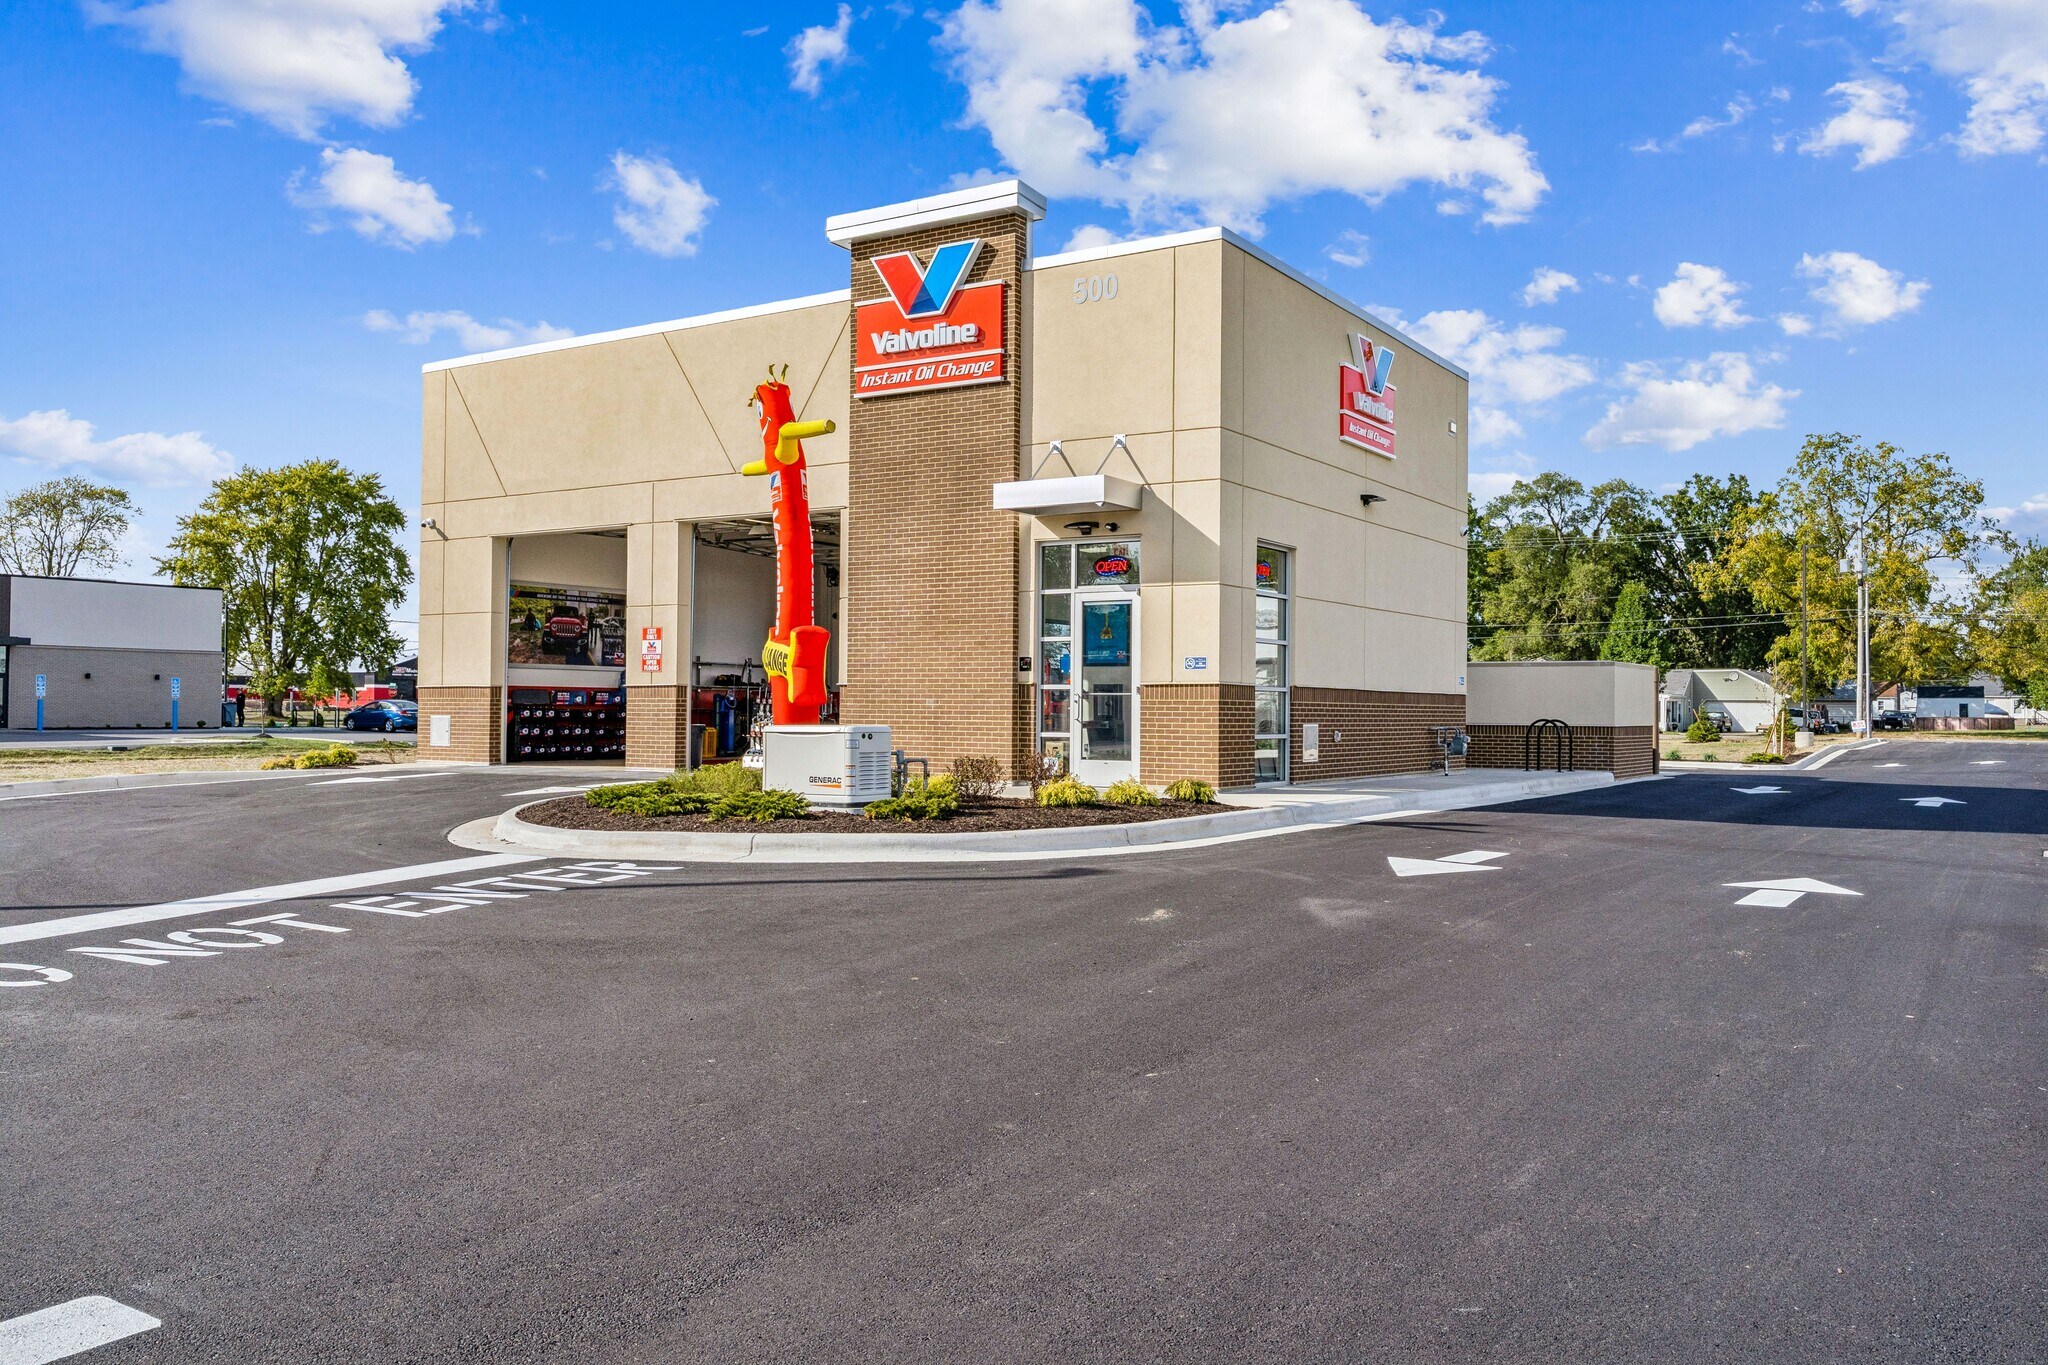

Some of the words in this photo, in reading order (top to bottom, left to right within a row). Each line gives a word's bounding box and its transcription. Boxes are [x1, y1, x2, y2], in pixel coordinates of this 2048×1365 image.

[1072, 272, 1119, 304] 500
[870, 322, 978, 355] Valvoline
[860, 368, 913, 388] Instant
[915, 365, 935, 380] Oil
[936, 360, 995, 378] Change
[1353, 391, 1394, 424] Valvoline
[1096, 560, 1128, 572] OPEN
[808, 776, 842, 784] GENERAC
[66, 912, 352, 966] NOT
[328, 861, 685, 918] ENTER
